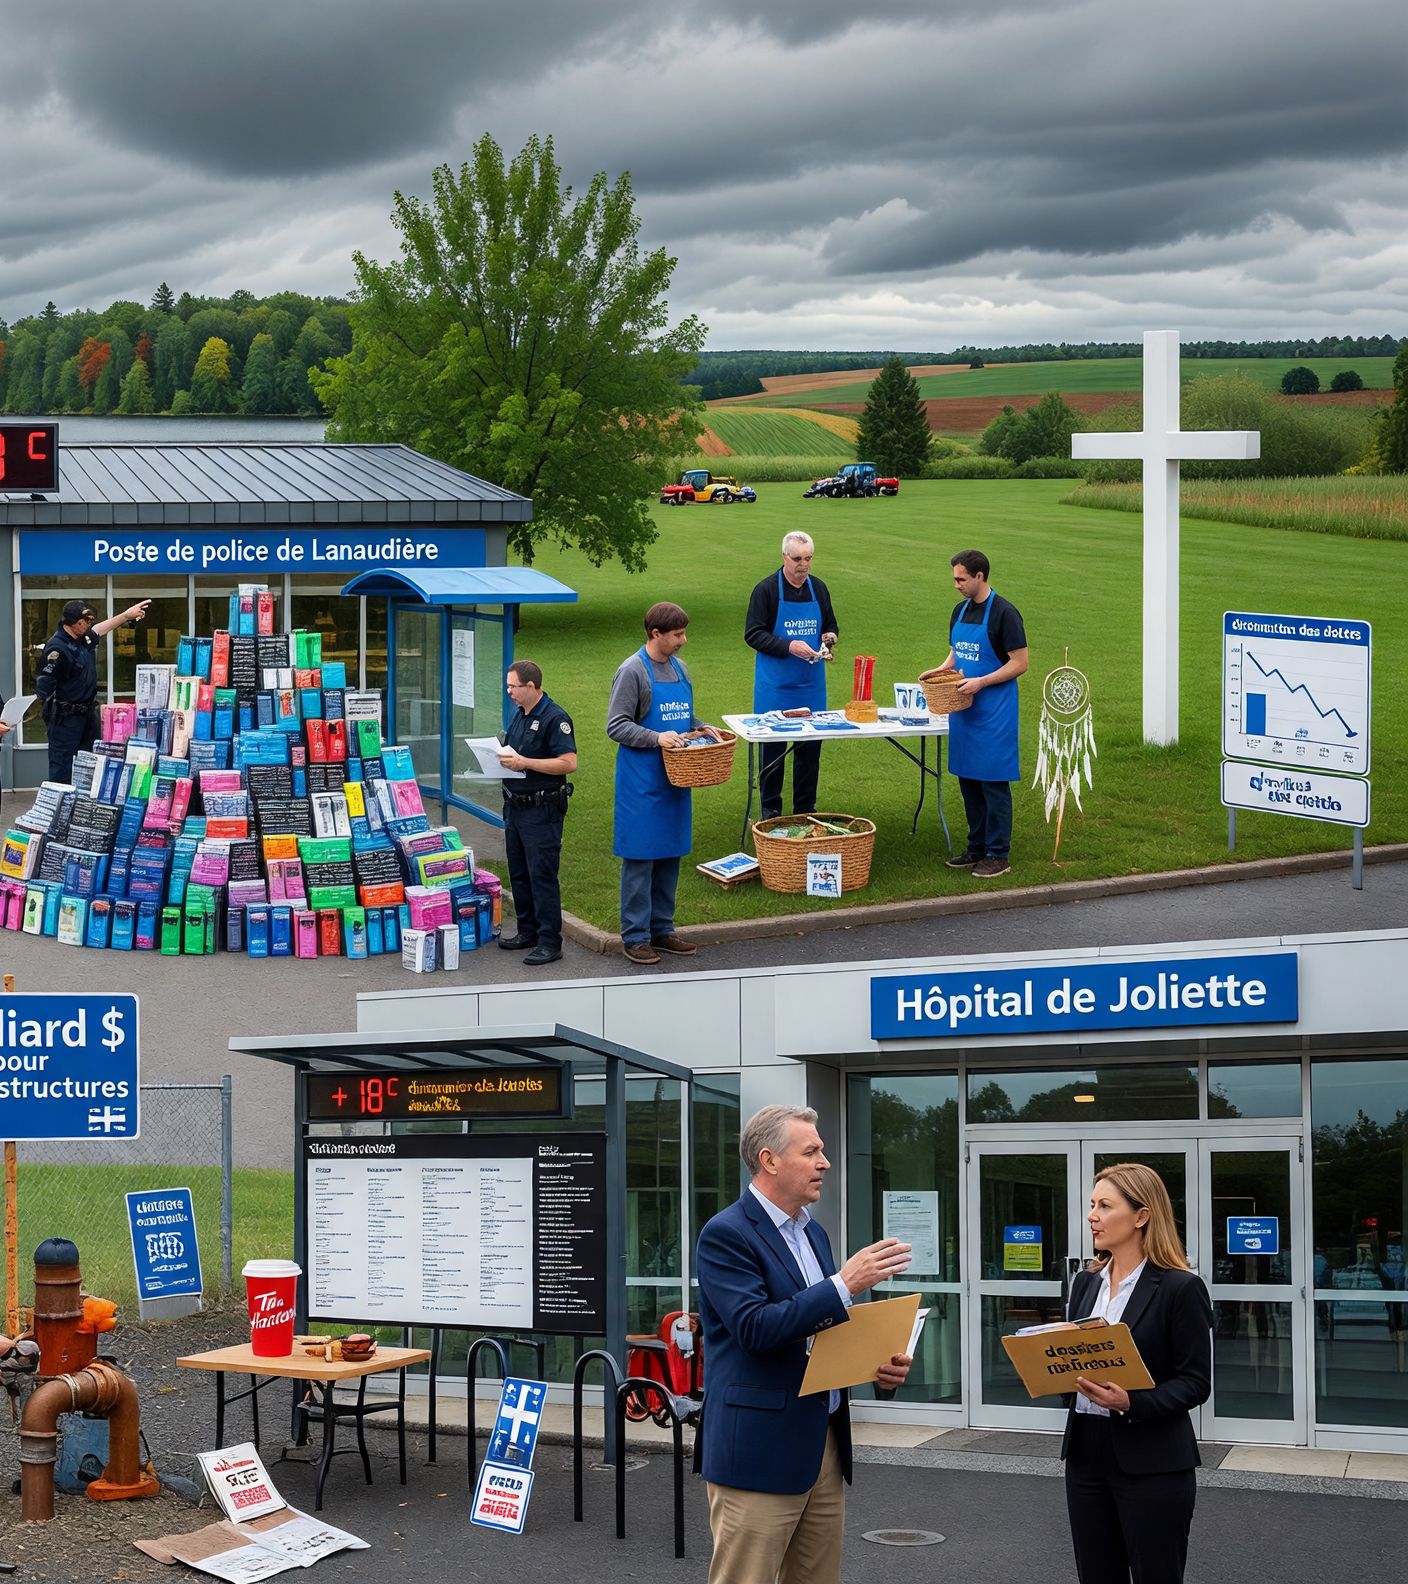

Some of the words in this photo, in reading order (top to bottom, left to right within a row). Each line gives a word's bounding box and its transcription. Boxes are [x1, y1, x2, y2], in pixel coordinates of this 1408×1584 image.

[94, 538, 159, 562] Poste
[166, 538, 195, 562] de
[202, 538, 269, 568] police
[276, 537, 304, 562] de
[312, 537, 439, 561] Lanaudière
[896, 980, 1033, 1029] Hôpital
[1046, 978, 1096, 1015] de
[1109, 972, 1267, 1013] Joliette
[101, 1005, 125, 1053] $
[360, 1078, 383, 1113] 18
